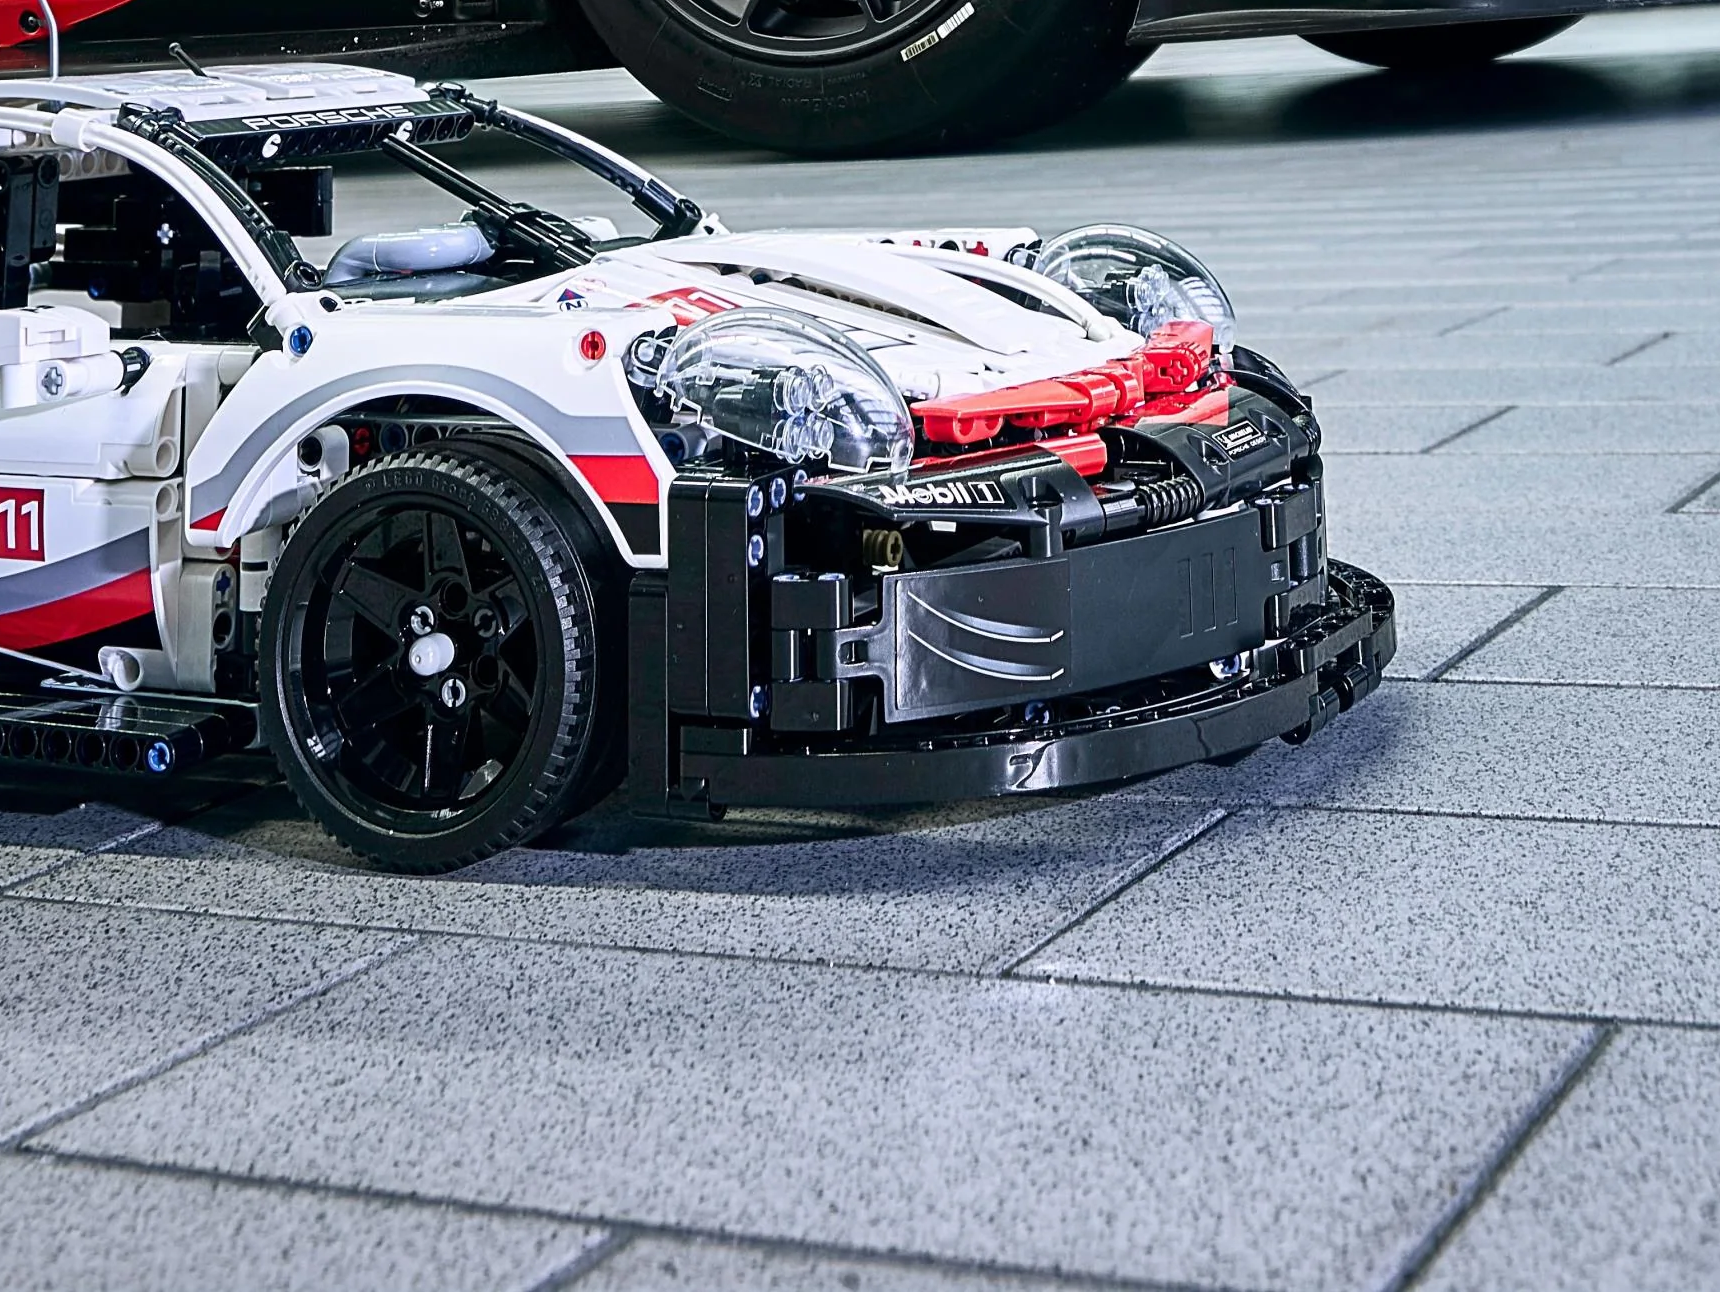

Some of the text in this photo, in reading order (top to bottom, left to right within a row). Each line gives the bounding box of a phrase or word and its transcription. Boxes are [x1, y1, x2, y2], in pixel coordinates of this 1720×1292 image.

[241, 104, 415, 131] PORSCHE
[382, 471, 424, 488] LEGO
[879, 482, 973, 505] Mobil
